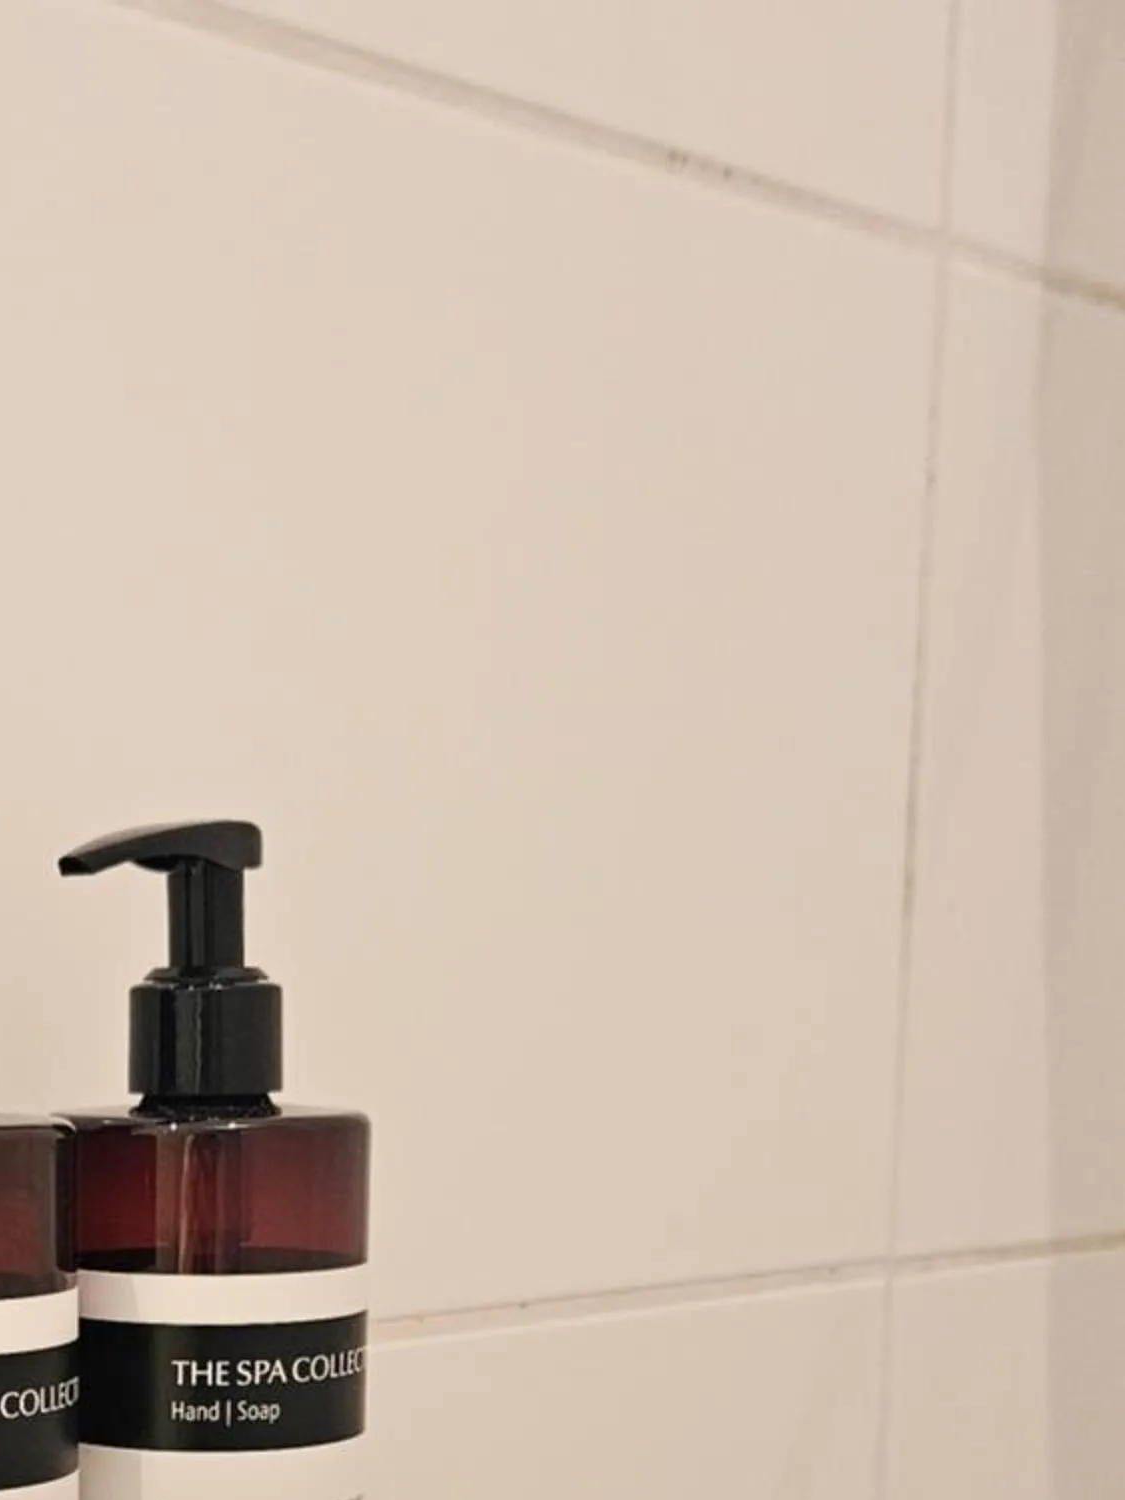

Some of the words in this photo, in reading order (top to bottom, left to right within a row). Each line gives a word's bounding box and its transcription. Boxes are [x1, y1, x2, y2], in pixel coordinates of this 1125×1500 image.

[171, 1360, 230, 1387] THE
[236, 1359, 288, 1386] SPA
[171, 1401, 220, 1422] Hand
[237, 1402, 280, 1425] Soap
